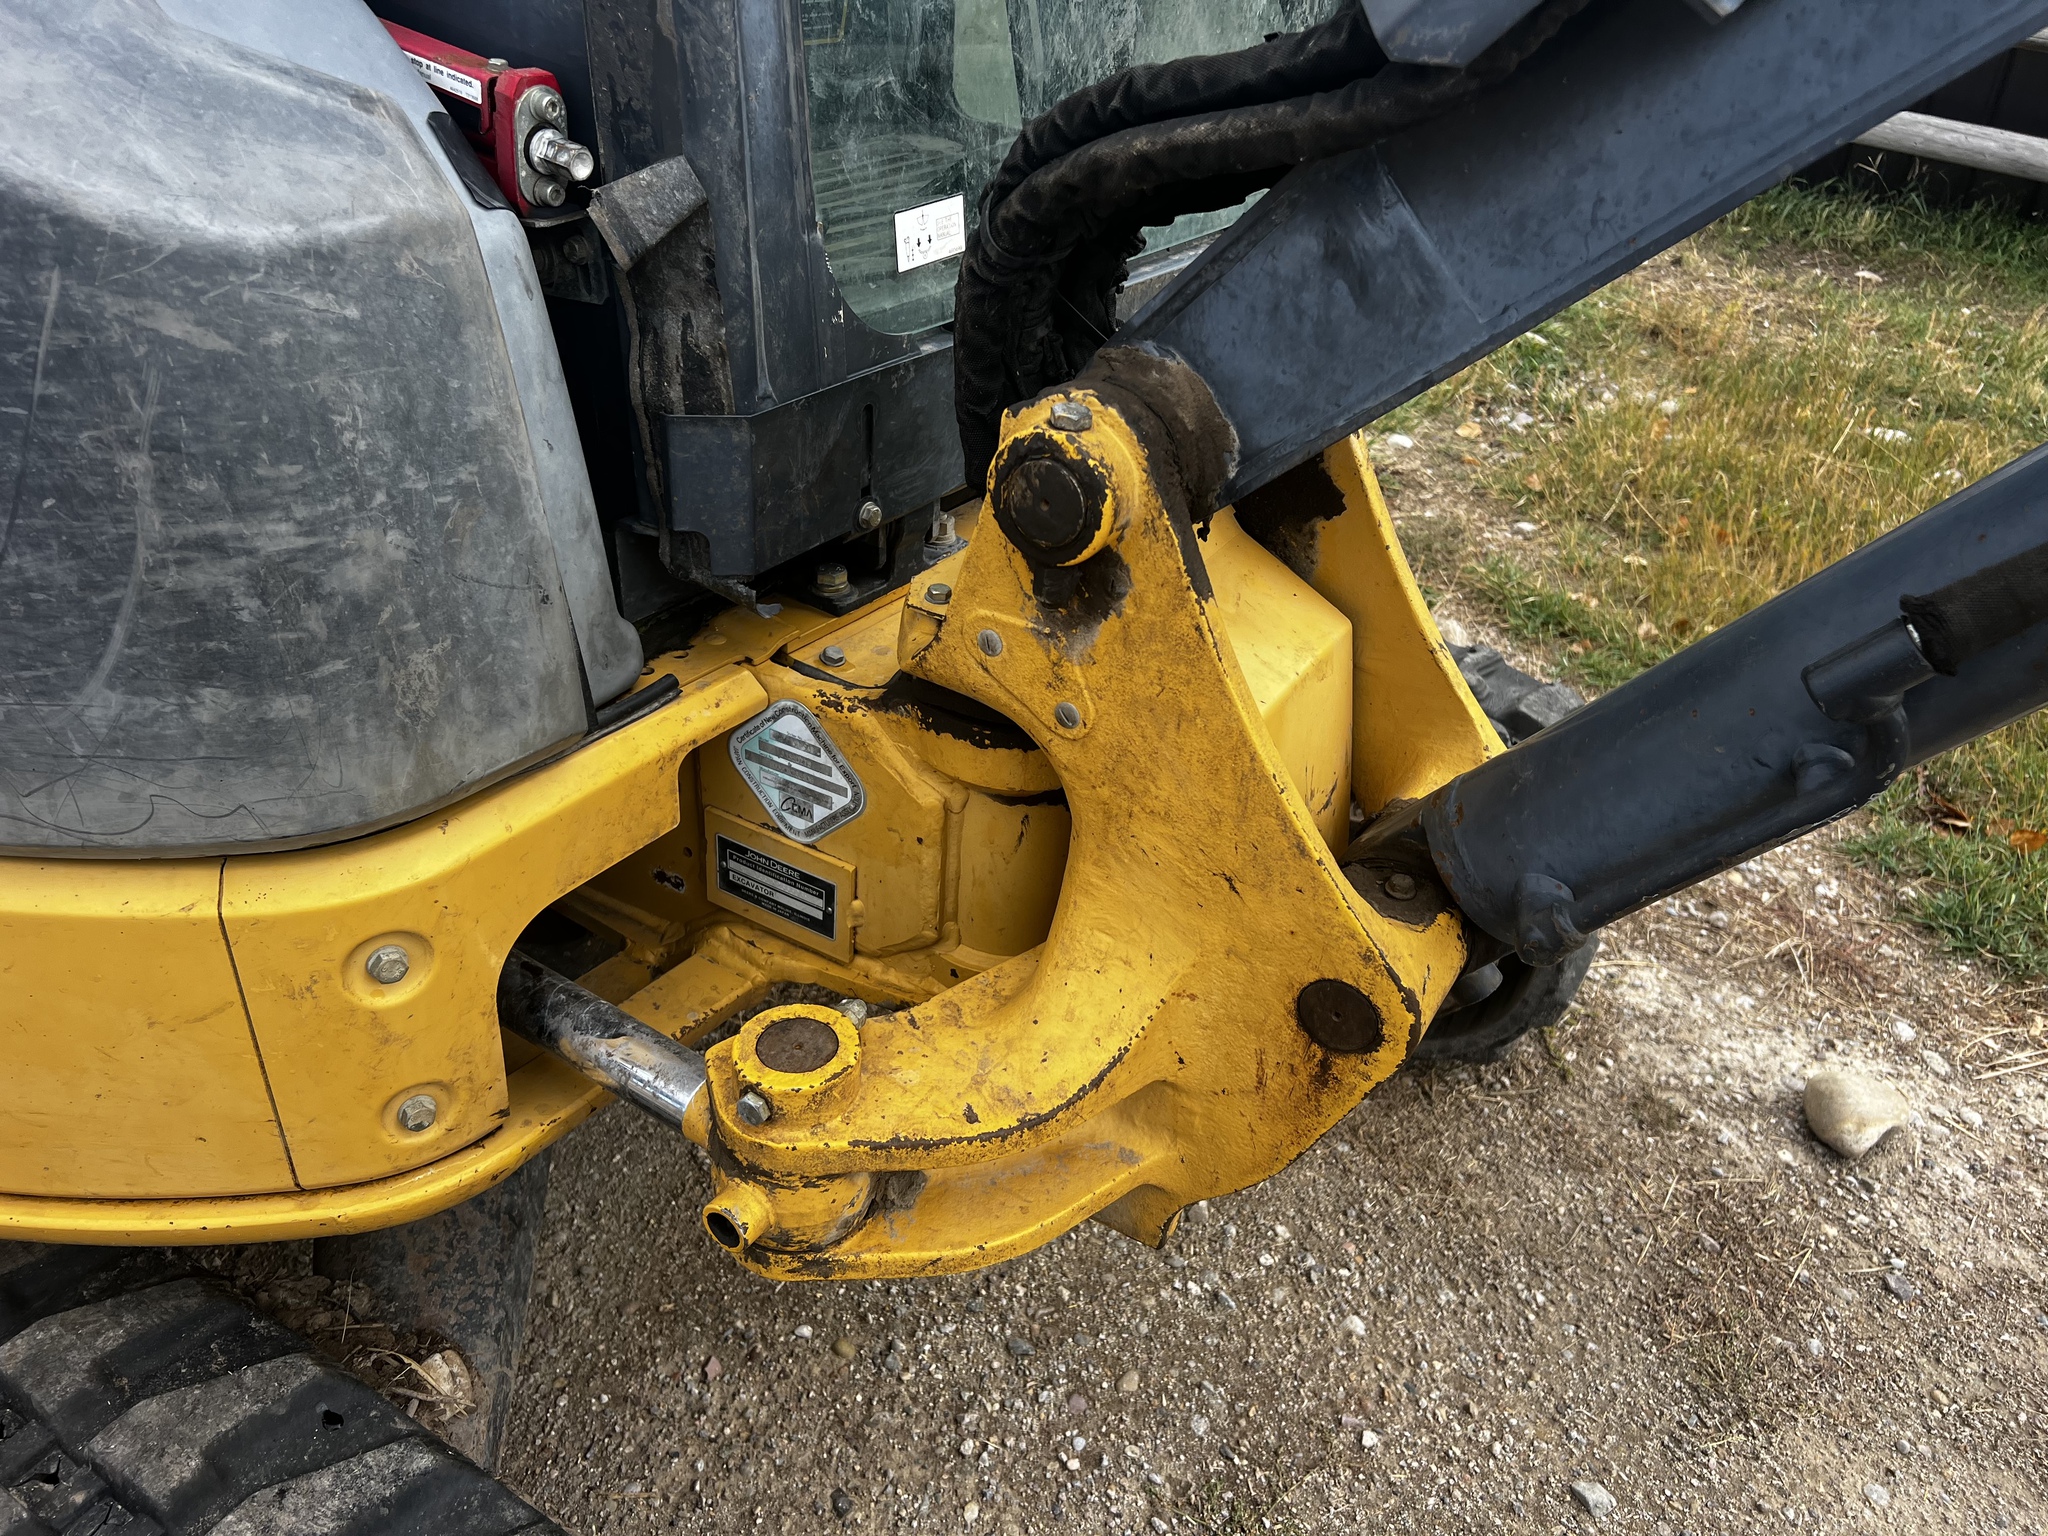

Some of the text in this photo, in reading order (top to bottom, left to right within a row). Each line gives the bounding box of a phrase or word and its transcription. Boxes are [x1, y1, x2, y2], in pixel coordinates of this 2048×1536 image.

[410, 57, 474, 88] stop at line indicated.
[736, 723, 761, 744] Certificate
[759, 719, 766, 728] of
[764, 715, 776, 725] New
[774, 706, 812, 728] Construction
[811, 726, 833, 756] Machine
[831, 754, 840, 764] for
[839, 764, 857, 788] Export
[733, 746, 743, 766] JAPAN
[741, 766, 773, 808] CONSTRUCTION
[732, 854, 819, 896] Product Identification Number
[744, 850, 800, 879] JOHN DEERE
[732, 873, 774, 898] EXCAVATOR
